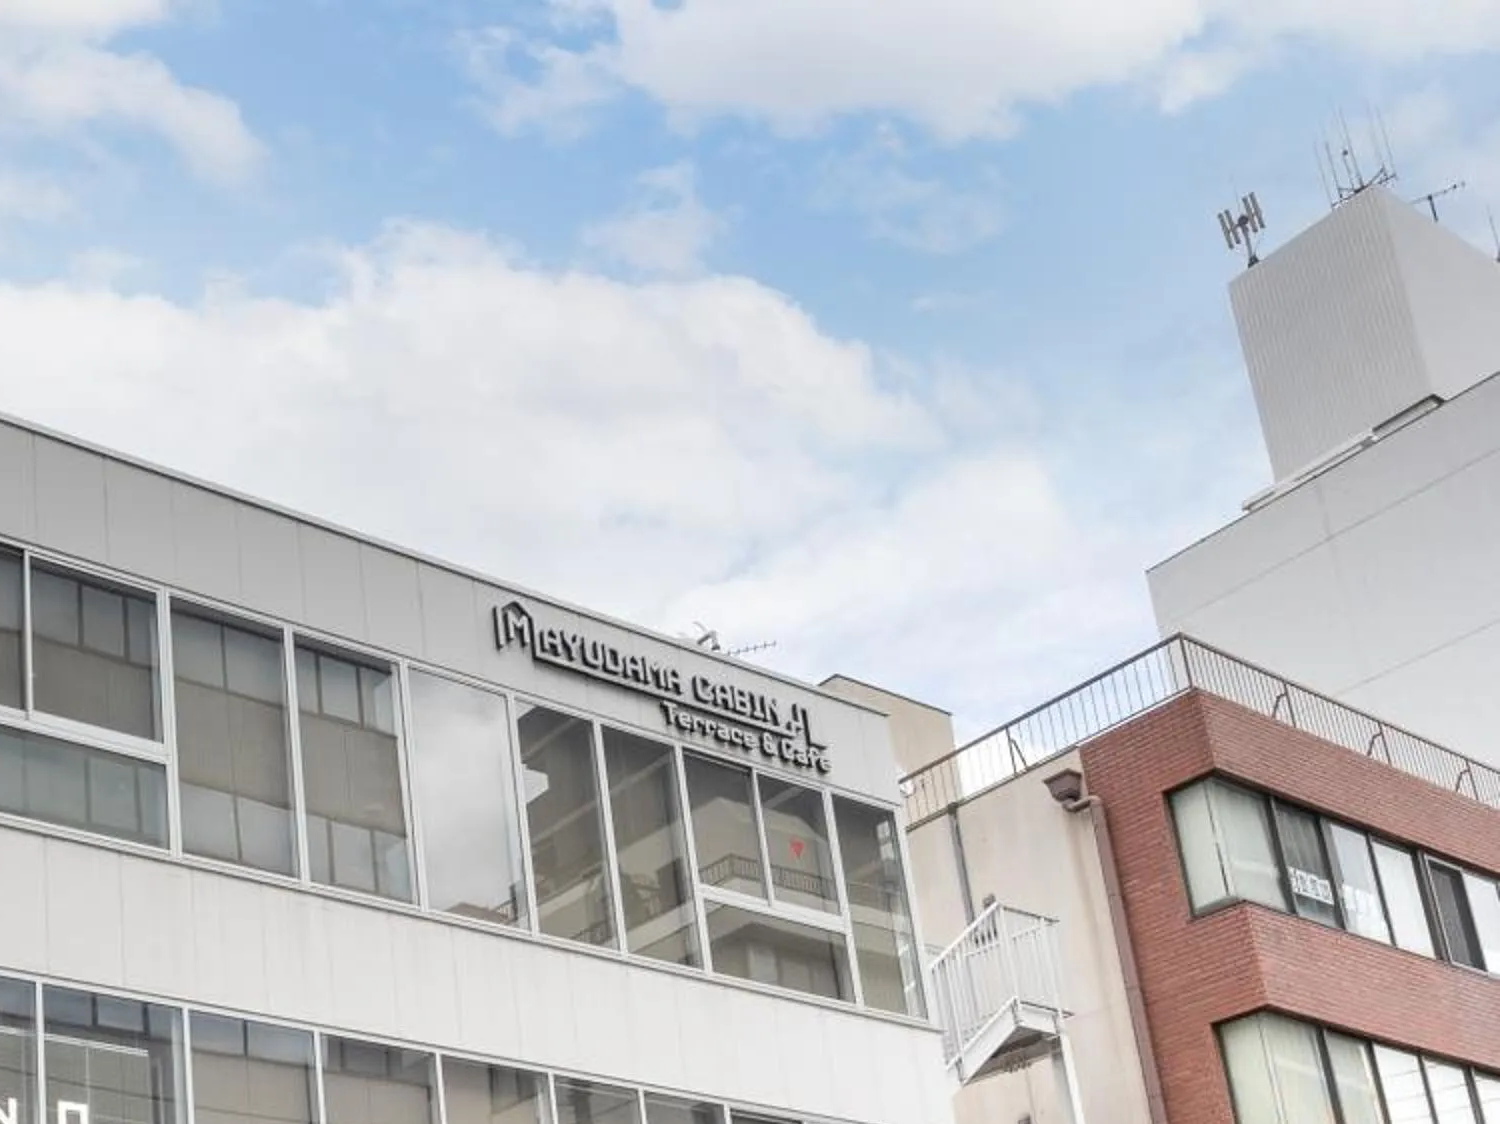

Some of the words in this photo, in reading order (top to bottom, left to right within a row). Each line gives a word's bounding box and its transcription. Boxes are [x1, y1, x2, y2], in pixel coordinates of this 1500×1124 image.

[500, 606, 683, 695] MAYUDAMA
[691, 676, 779, 722] CABIN
[660, 701, 756, 750] Terrace
[762, 732, 777, 756] &
[780, 738, 832, 773] Cafe
